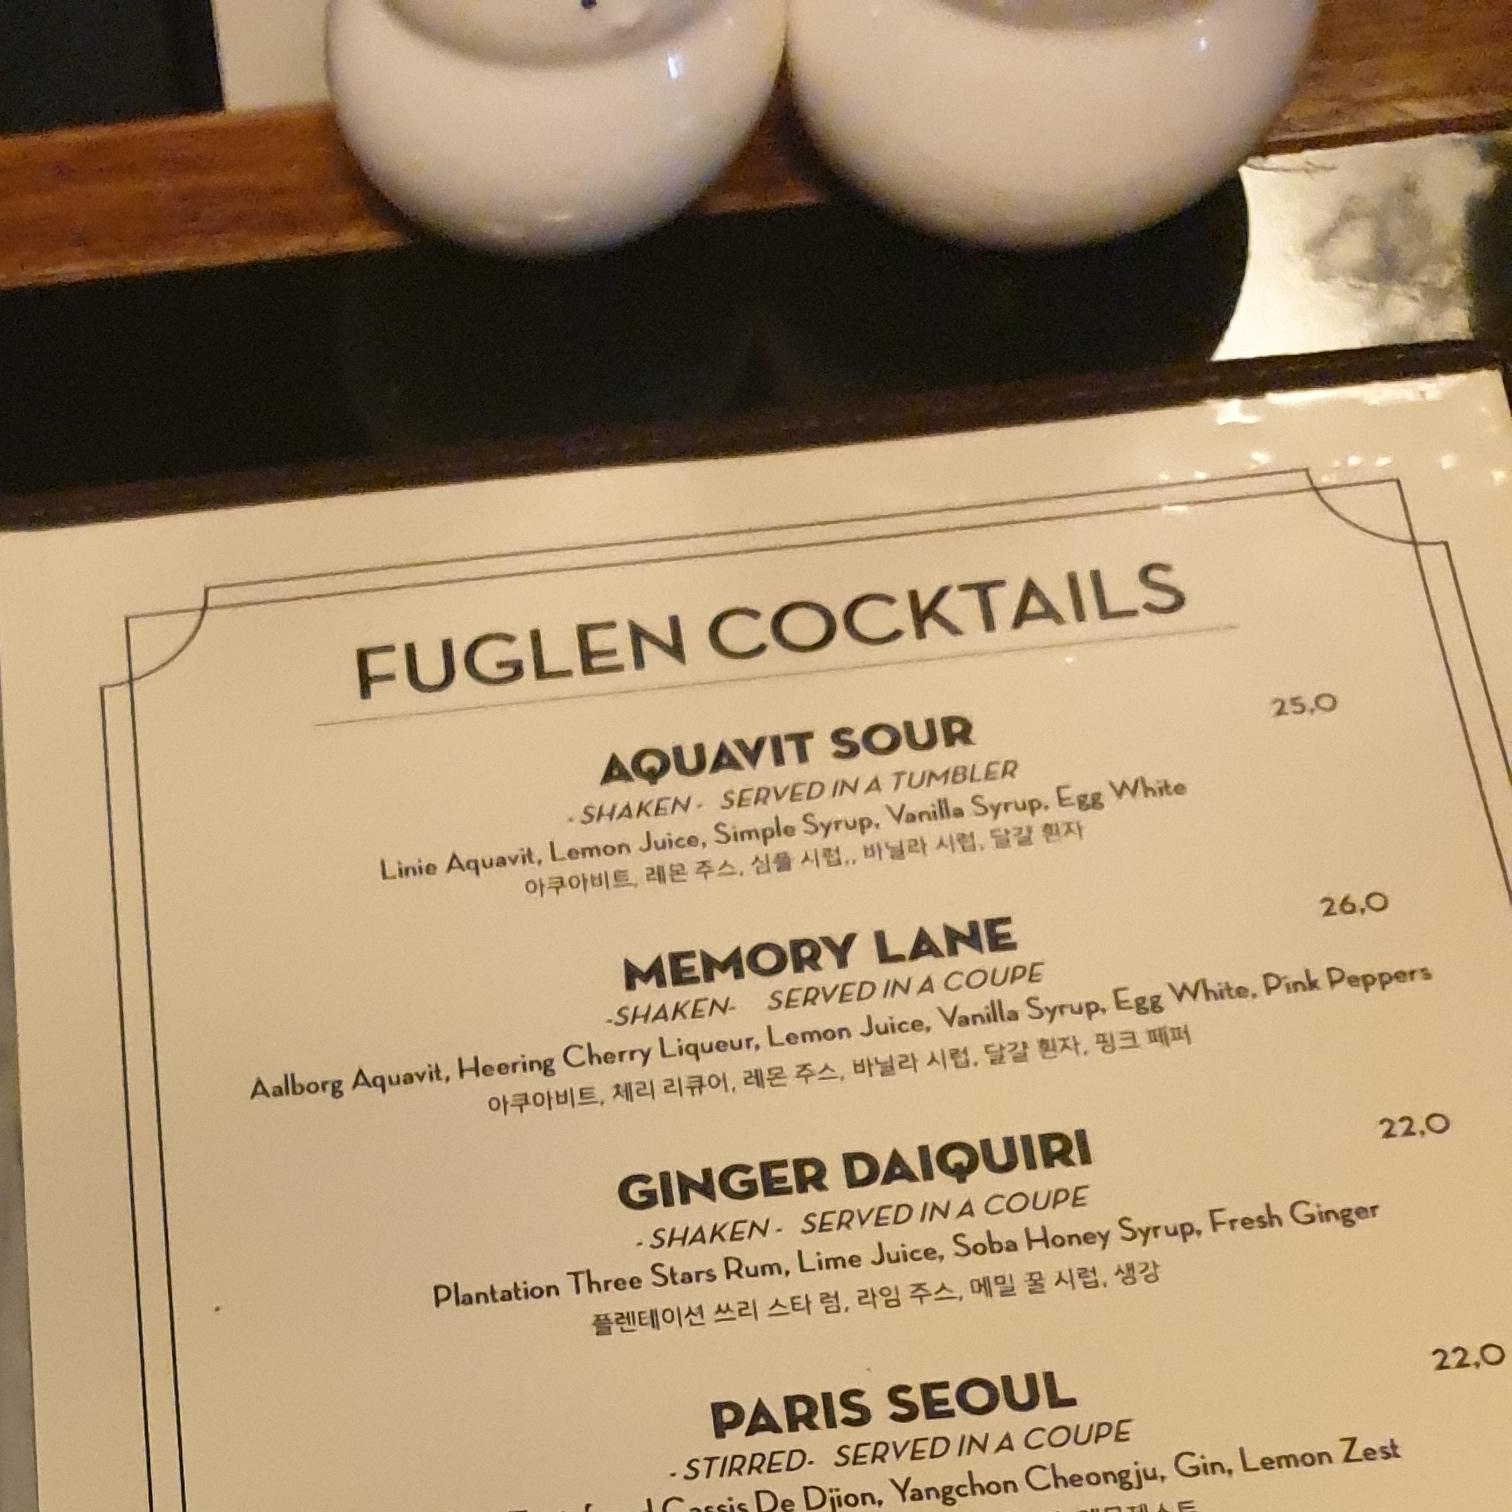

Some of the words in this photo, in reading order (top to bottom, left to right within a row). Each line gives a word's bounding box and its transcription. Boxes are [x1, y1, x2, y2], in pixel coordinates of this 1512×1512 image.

[356, 614, 686, 700] FUGLEN
[708, 562, 1186, 660] COCKTAILS
[600, 731, 814, 786] AQUAVIT
[830, 715, 975, 760] SOUR
[380, 859, 437, 880] Linie
[446, 848, 542, 876] Aquavit,
[549, 841, 631, 862] Lemon
[639, 831, 706, 852] Juice,
[714, 815, 796, 846] Simple
[802, 813, 879, 838] Syrup,
[886, 798, 964, 824] Vanilla
[971, 795, 1049, 820] Syrup,
[1056, 785, 1104, 811] Egg
[1109, 776, 1186, 799] White
[624, 932, 857, 992] MEMORY
[874, 916, 1018, 964] LANE
[617, 1157, 829, 1211] GINGER
[842, 1129, 1092, 1189] DAIQUIRI
[433, 1281, 560, 1308] Plantation
[566, 1269, 642, 1295] Three
[650, 1262, 717, 1287] Stars
[723, 1256, 790, 1280] Rum,
[797, 1249, 862, 1273] Lime
[871, 1241, 944, 1266] Juice,
[952, 1230, 1018, 1257] Soba
[1024, 1225, 1110, 1251] Honey
[1118, 1216, 1202, 1246] Syrup,
[1209, 1202, 1283, 1232] Fresh
[1289, 1200, 1379, 1228] Ginger
[710, 1388, 872, 1439] PARIS
[887, 1371, 1078, 1423] SEOUL
[889, 1470, 1019, 1507] Yangchon
[1024, 1461, 1166, 1491] Cheongju,
[1174, 1451, 1233, 1478] Gin,
[1239, 1447, 1333, 1472] Lemon
[1339, 1437, 1401, 1463] Zest
